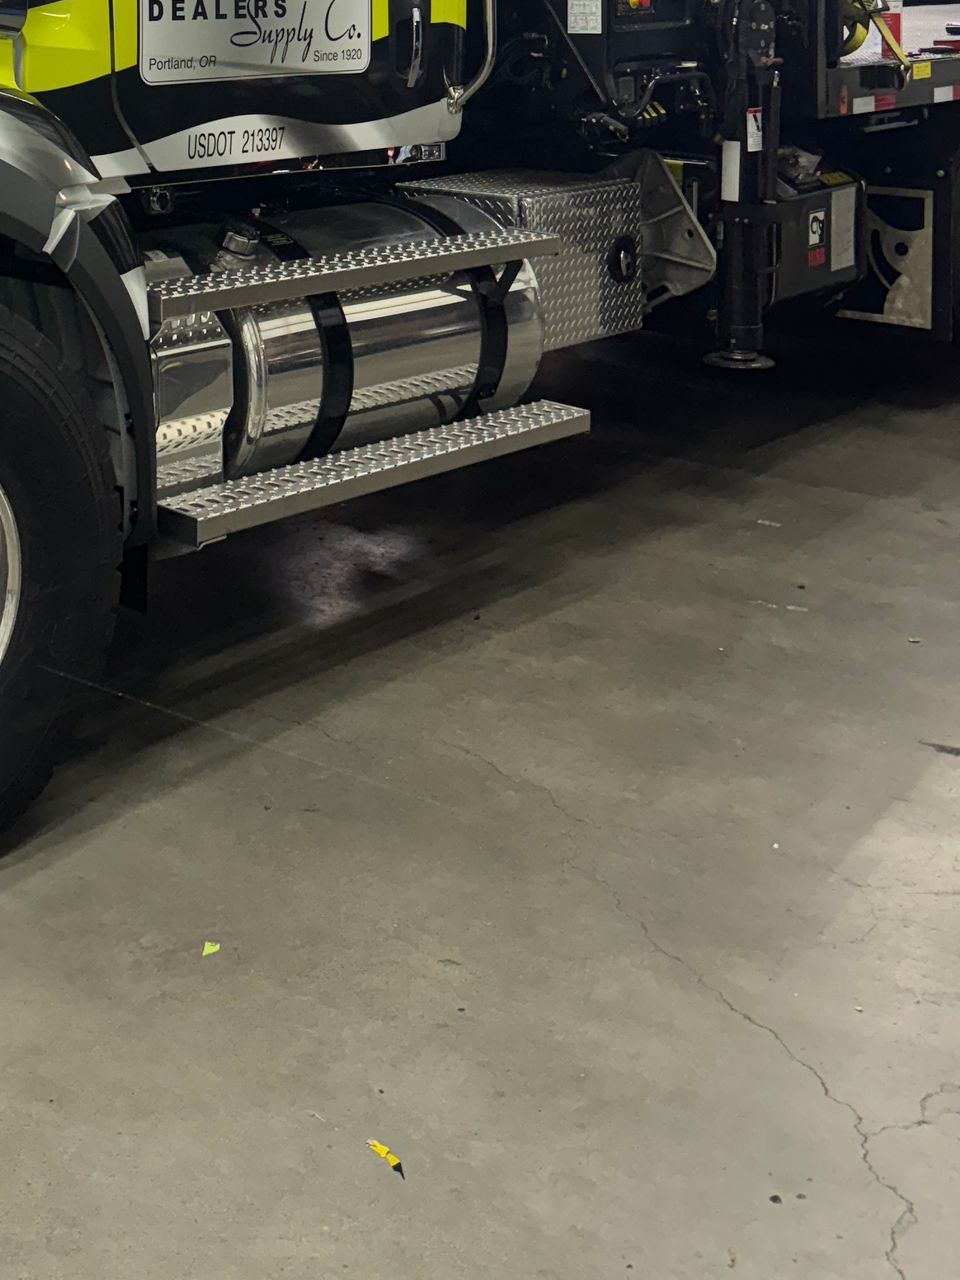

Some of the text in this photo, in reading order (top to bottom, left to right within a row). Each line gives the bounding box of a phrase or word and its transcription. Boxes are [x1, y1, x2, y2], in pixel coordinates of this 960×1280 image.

[148, 55, 217, 71] Portland, OR
[313, 48, 362, 62] Since 1920
[187, 127, 286, 160] USDOT 213397
